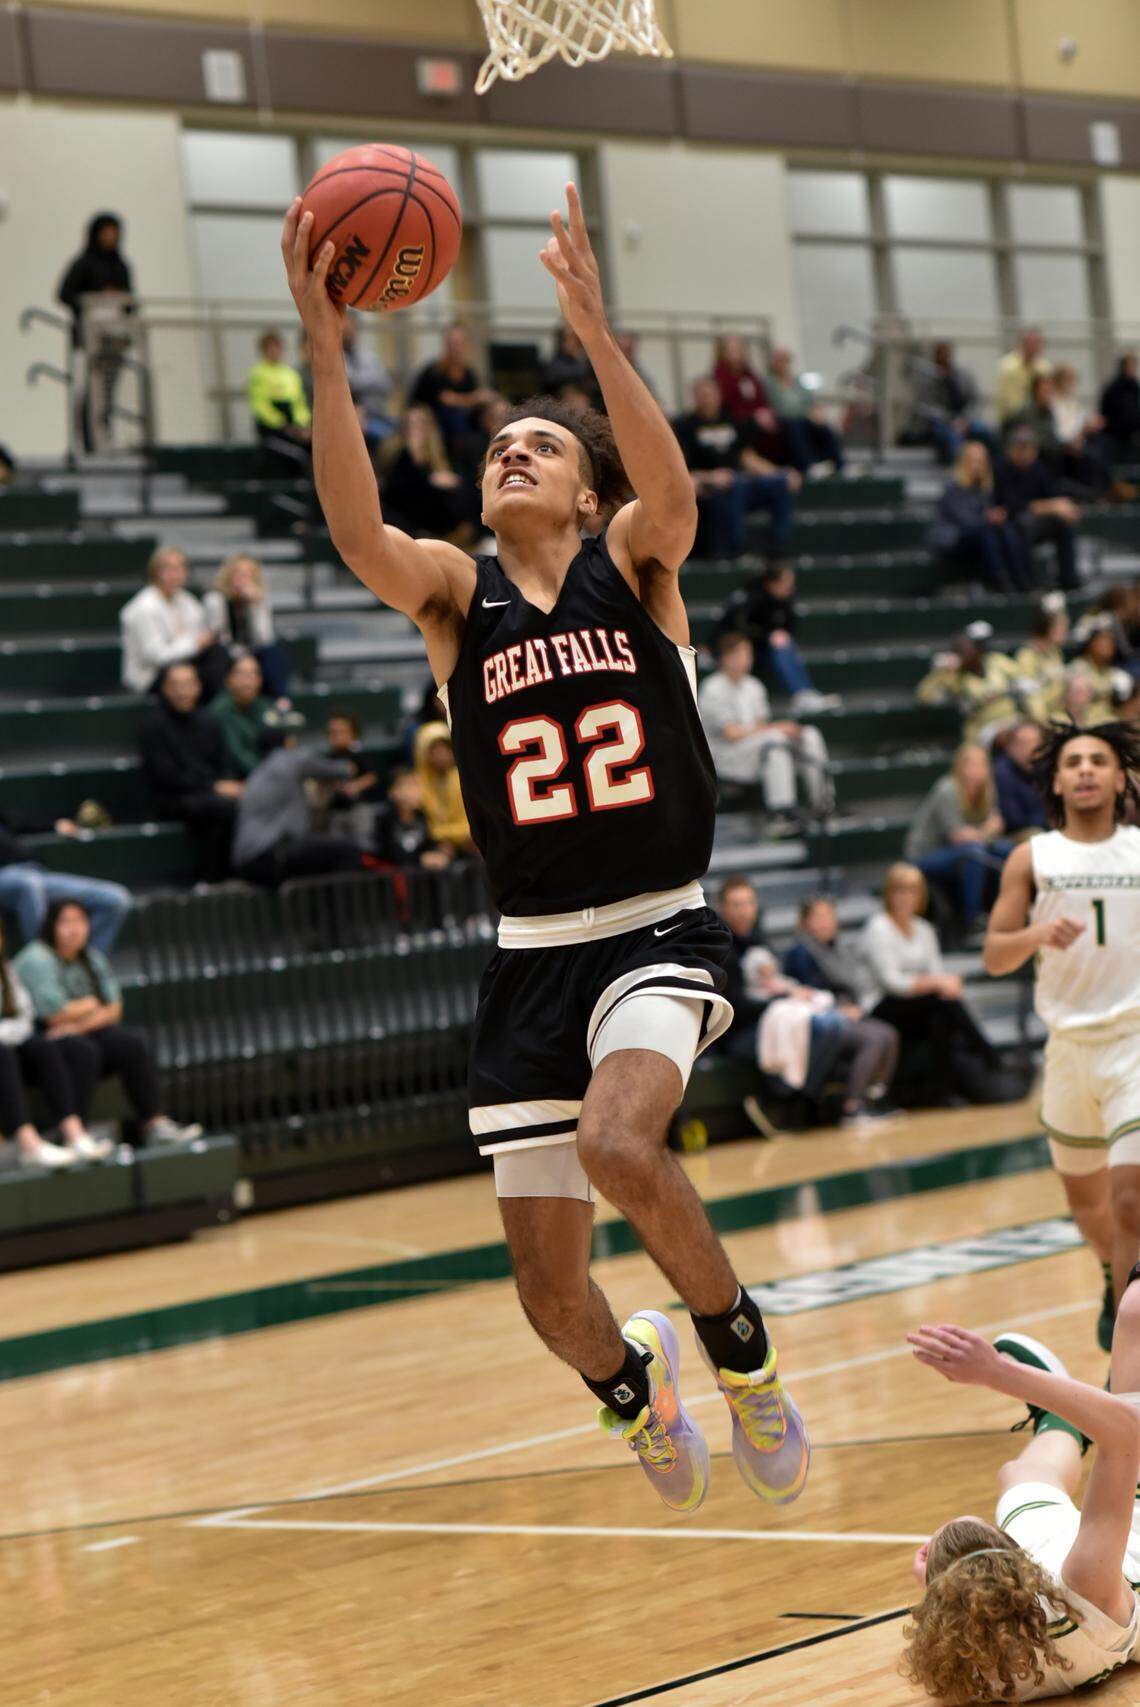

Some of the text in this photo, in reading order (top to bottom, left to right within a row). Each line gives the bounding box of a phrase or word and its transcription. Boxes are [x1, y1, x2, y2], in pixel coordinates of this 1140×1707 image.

[372, 243, 425, 308] Wil
[482, 627, 637, 704] GREAT FALLS
[497, 699, 655, 825] 22
[1090, 898, 1106, 947] 1
